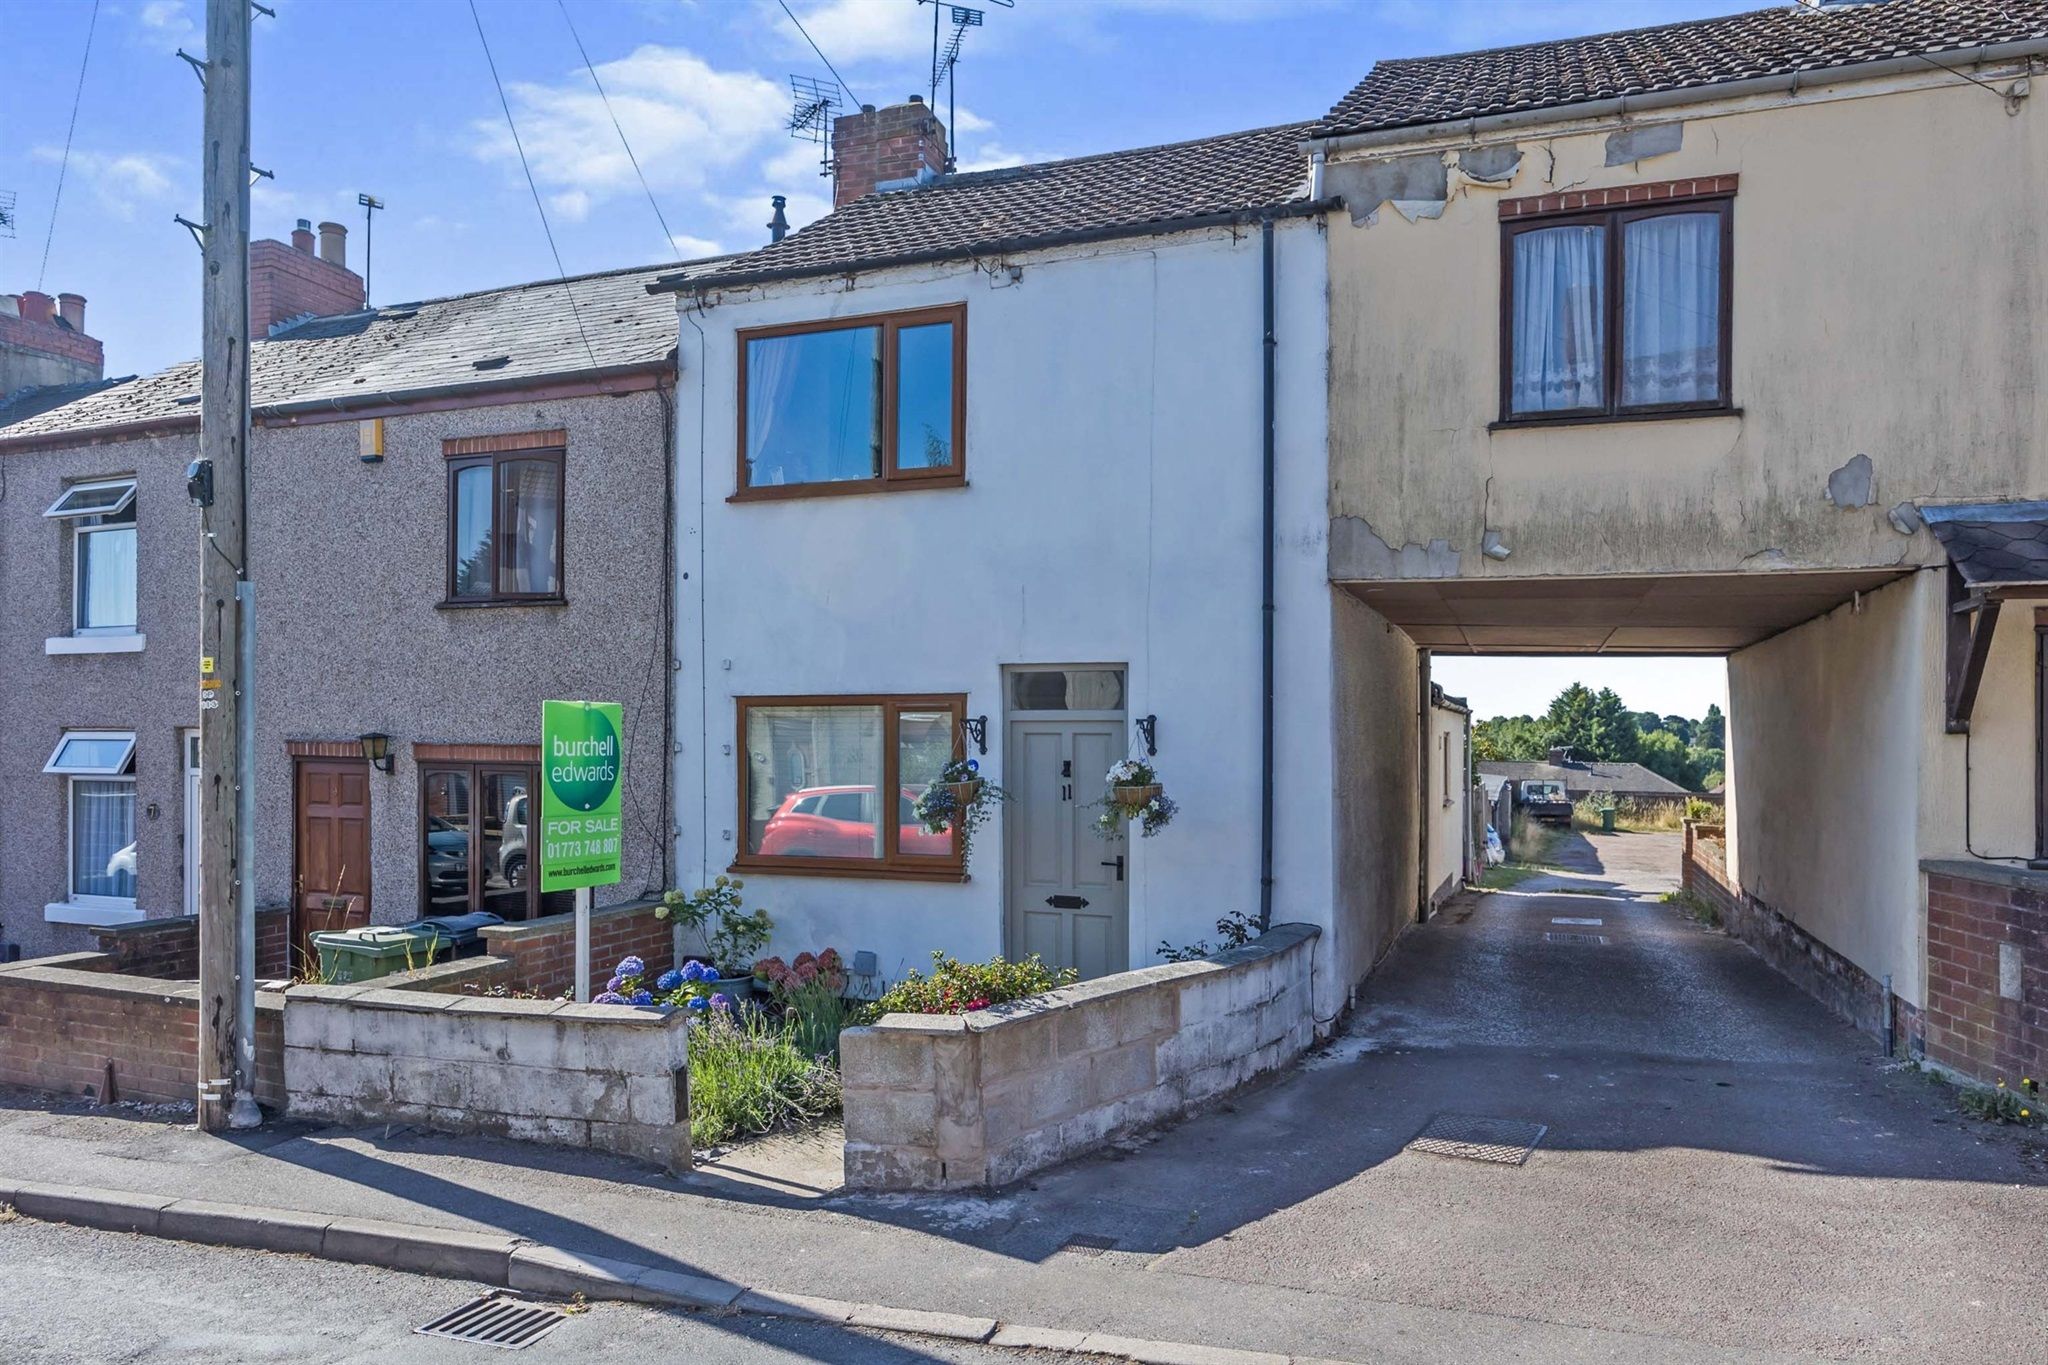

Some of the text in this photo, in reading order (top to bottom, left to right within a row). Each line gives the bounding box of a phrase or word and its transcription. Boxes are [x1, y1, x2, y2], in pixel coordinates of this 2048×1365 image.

[553, 735, 613, 757] burchell
[552, 760, 615, 783] edwards
[1062, 784, 1072, 801] 11
[548, 818, 619, 835] FOR SALE
[547, 838, 618, 858] 01773 748 807
